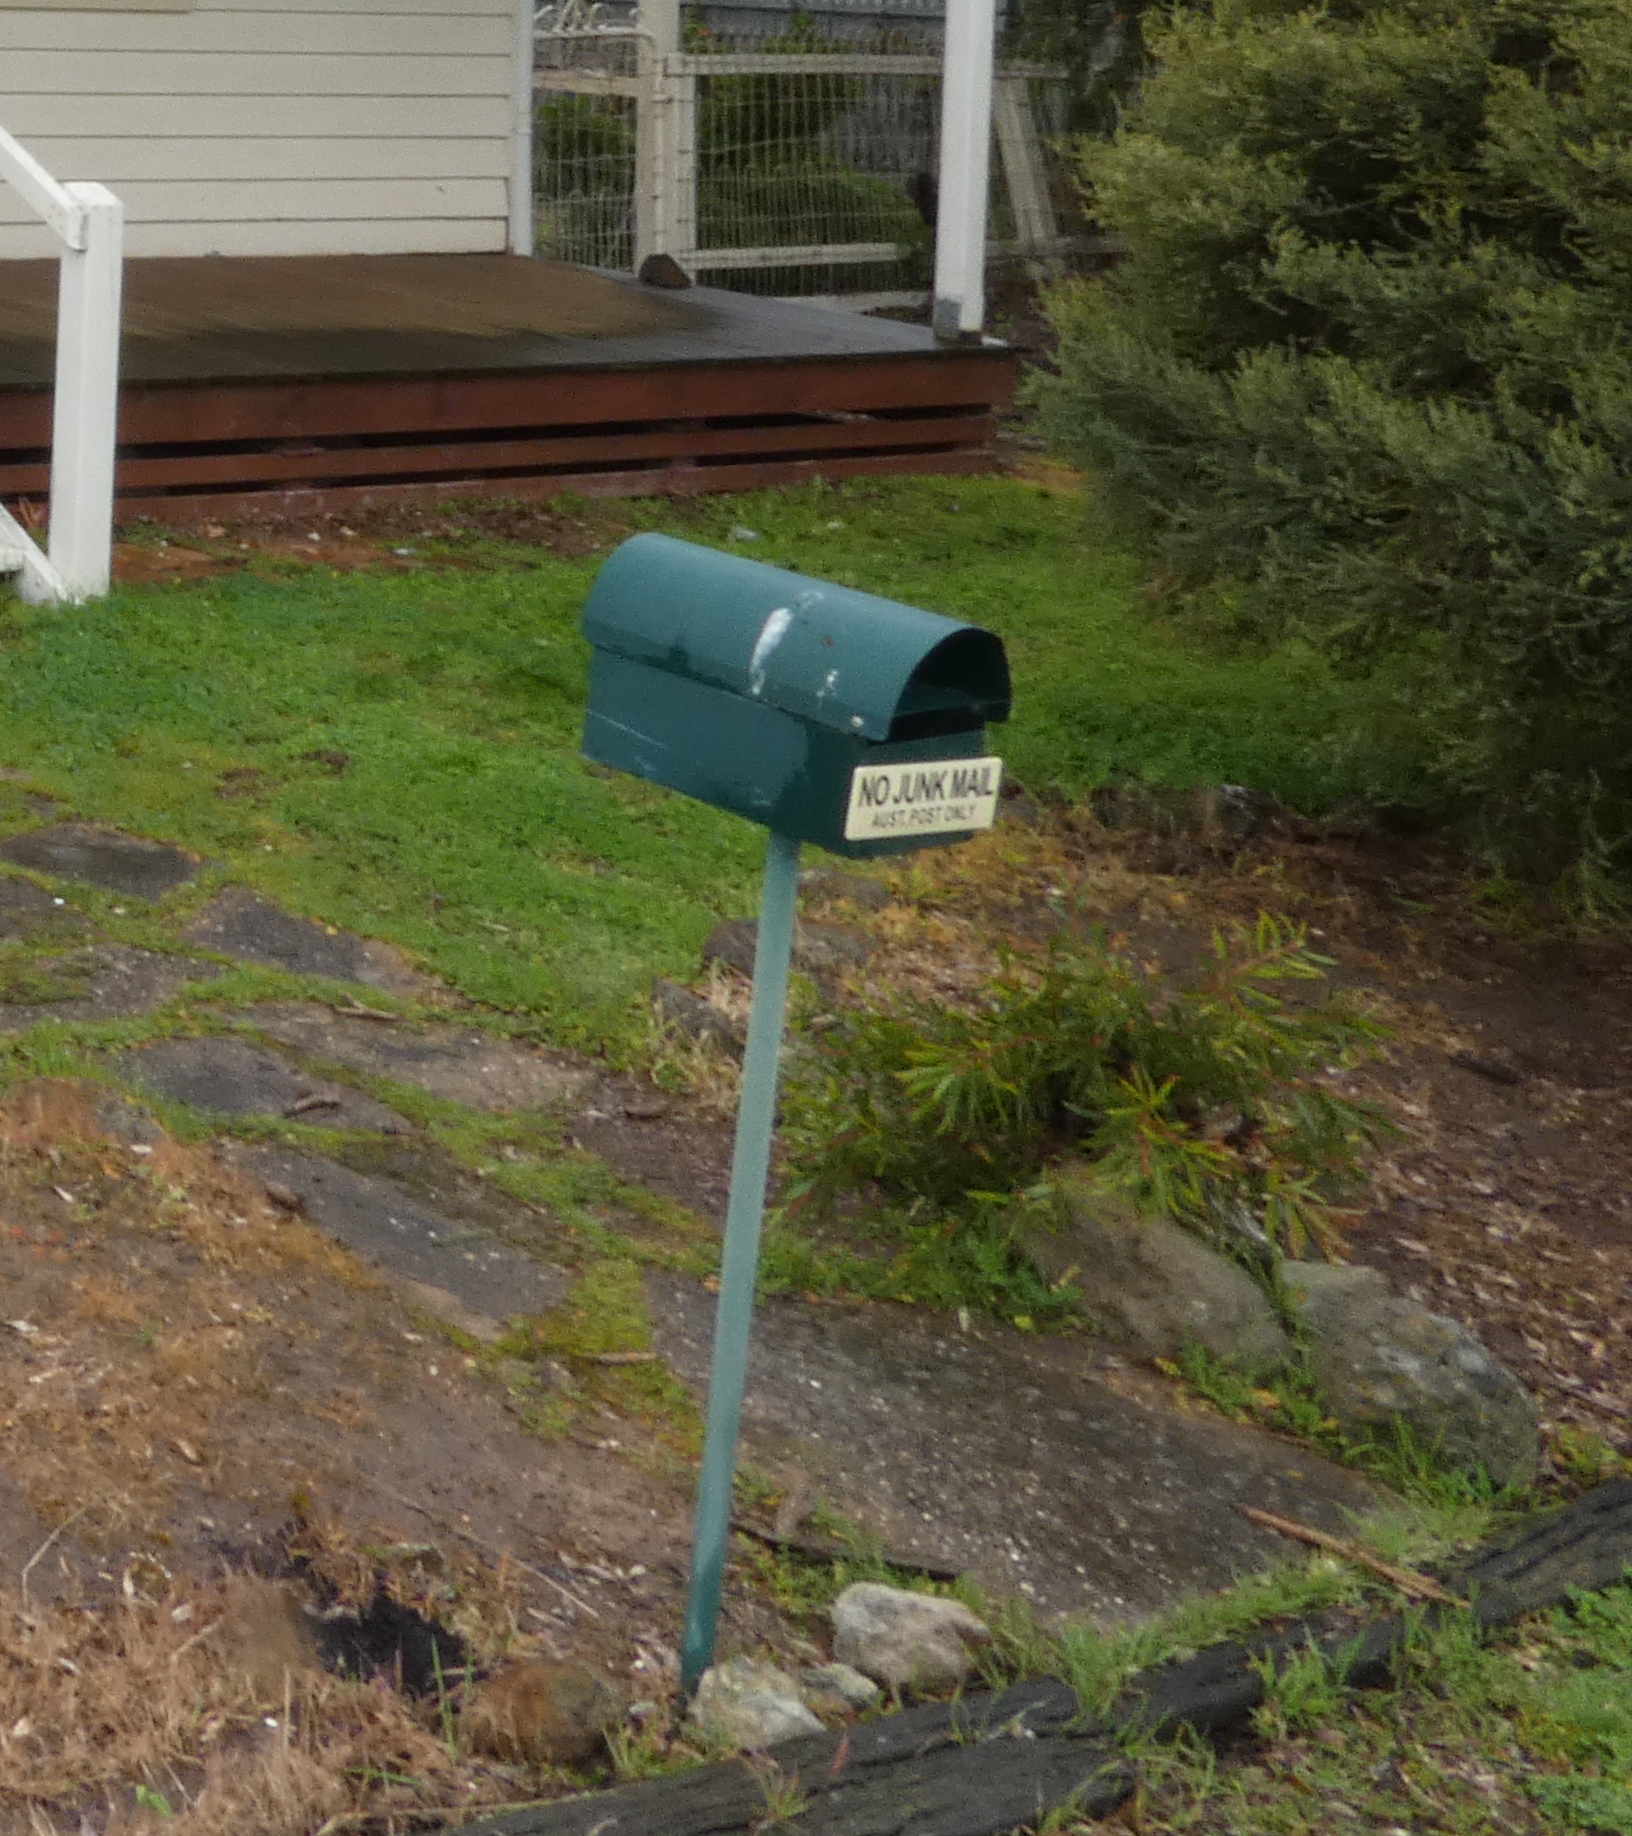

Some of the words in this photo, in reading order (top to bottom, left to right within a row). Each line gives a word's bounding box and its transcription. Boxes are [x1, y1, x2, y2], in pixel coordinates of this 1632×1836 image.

[858, 774, 891, 807] NO
[892, 769, 949, 804] JUNK
[949, 766, 994, 799] MAIL
[908, 805, 944, 825] POST
[943, 802, 977, 822] ONLY
